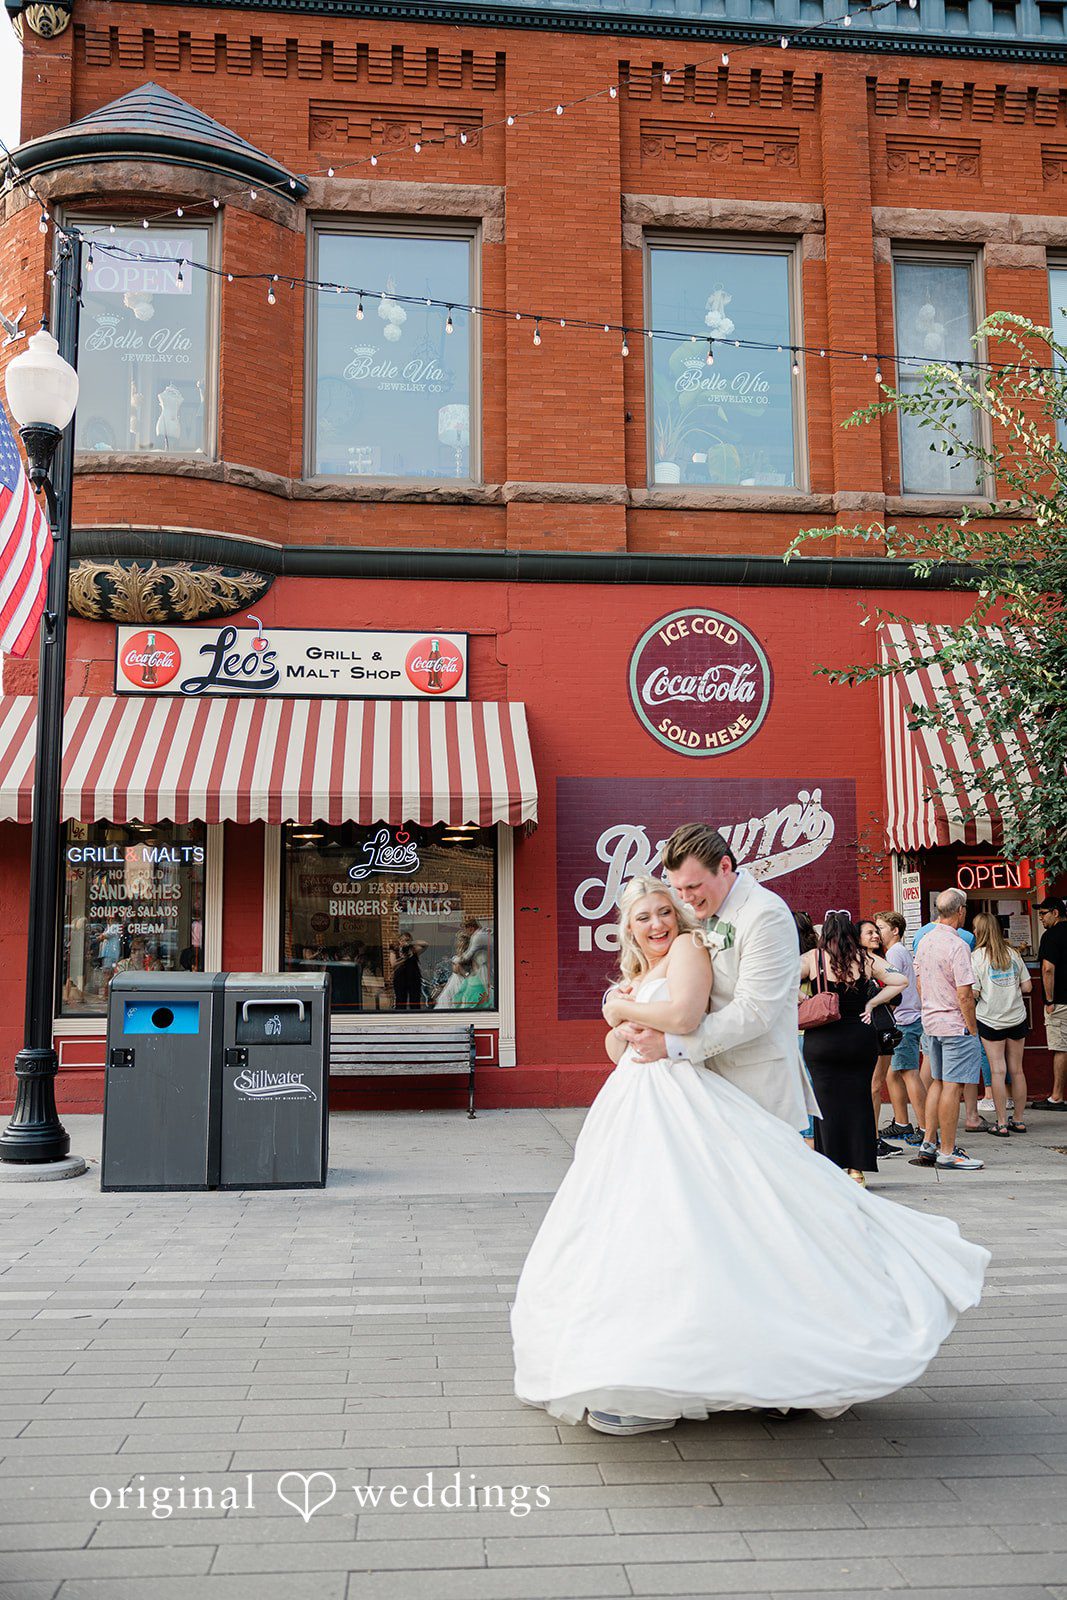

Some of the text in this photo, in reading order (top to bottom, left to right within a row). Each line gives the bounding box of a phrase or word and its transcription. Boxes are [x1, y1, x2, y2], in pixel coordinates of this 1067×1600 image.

[96, 238, 183, 263] NOW
[94, 266, 183, 291] OPEN
[85, 325, 192, 353] Belle Via
[121, 353, 192, 363] JEWELRY CO.
[343, 355, 445, 382] Belle Via
[378, 382, 444, 393] JEWELRY CO.
[675, 368, 770, 395] Belle Via
[708, 395, 771, 404] JEWELRY CO.
[658, 617, 738, 646] ICE COLD
[306, 646, 383, 661] GRILL &
[286, 665, 401, 680] MALT SHOP
[642, 663, 757, 706] Coca-Cola
[658, 713, 752, 747] SOLD HERE
[67, 846, 205, 863] GRILL & MALTS
[574, 788, 835, 919] Bwn's
[108, 869, 128, 880] HOT
[957, 864, 1021, 890] OPEN
[89, 883, 182, 901] SANDWICHES
[332, 882, 362, 895] OLD
[368, 882, 449, 895] FASHIONED
[903, 886, 920, 901] OPEN
[89, 905, 178, 918] SOUPS & SALADS
[329, 899, 452, 916] BURGERS & MALTS
[107, 923, 165, 934] ICE CREAM
[578, 923, 621, 951] IC
[233, 1069, 305, 1090] Stillwater
